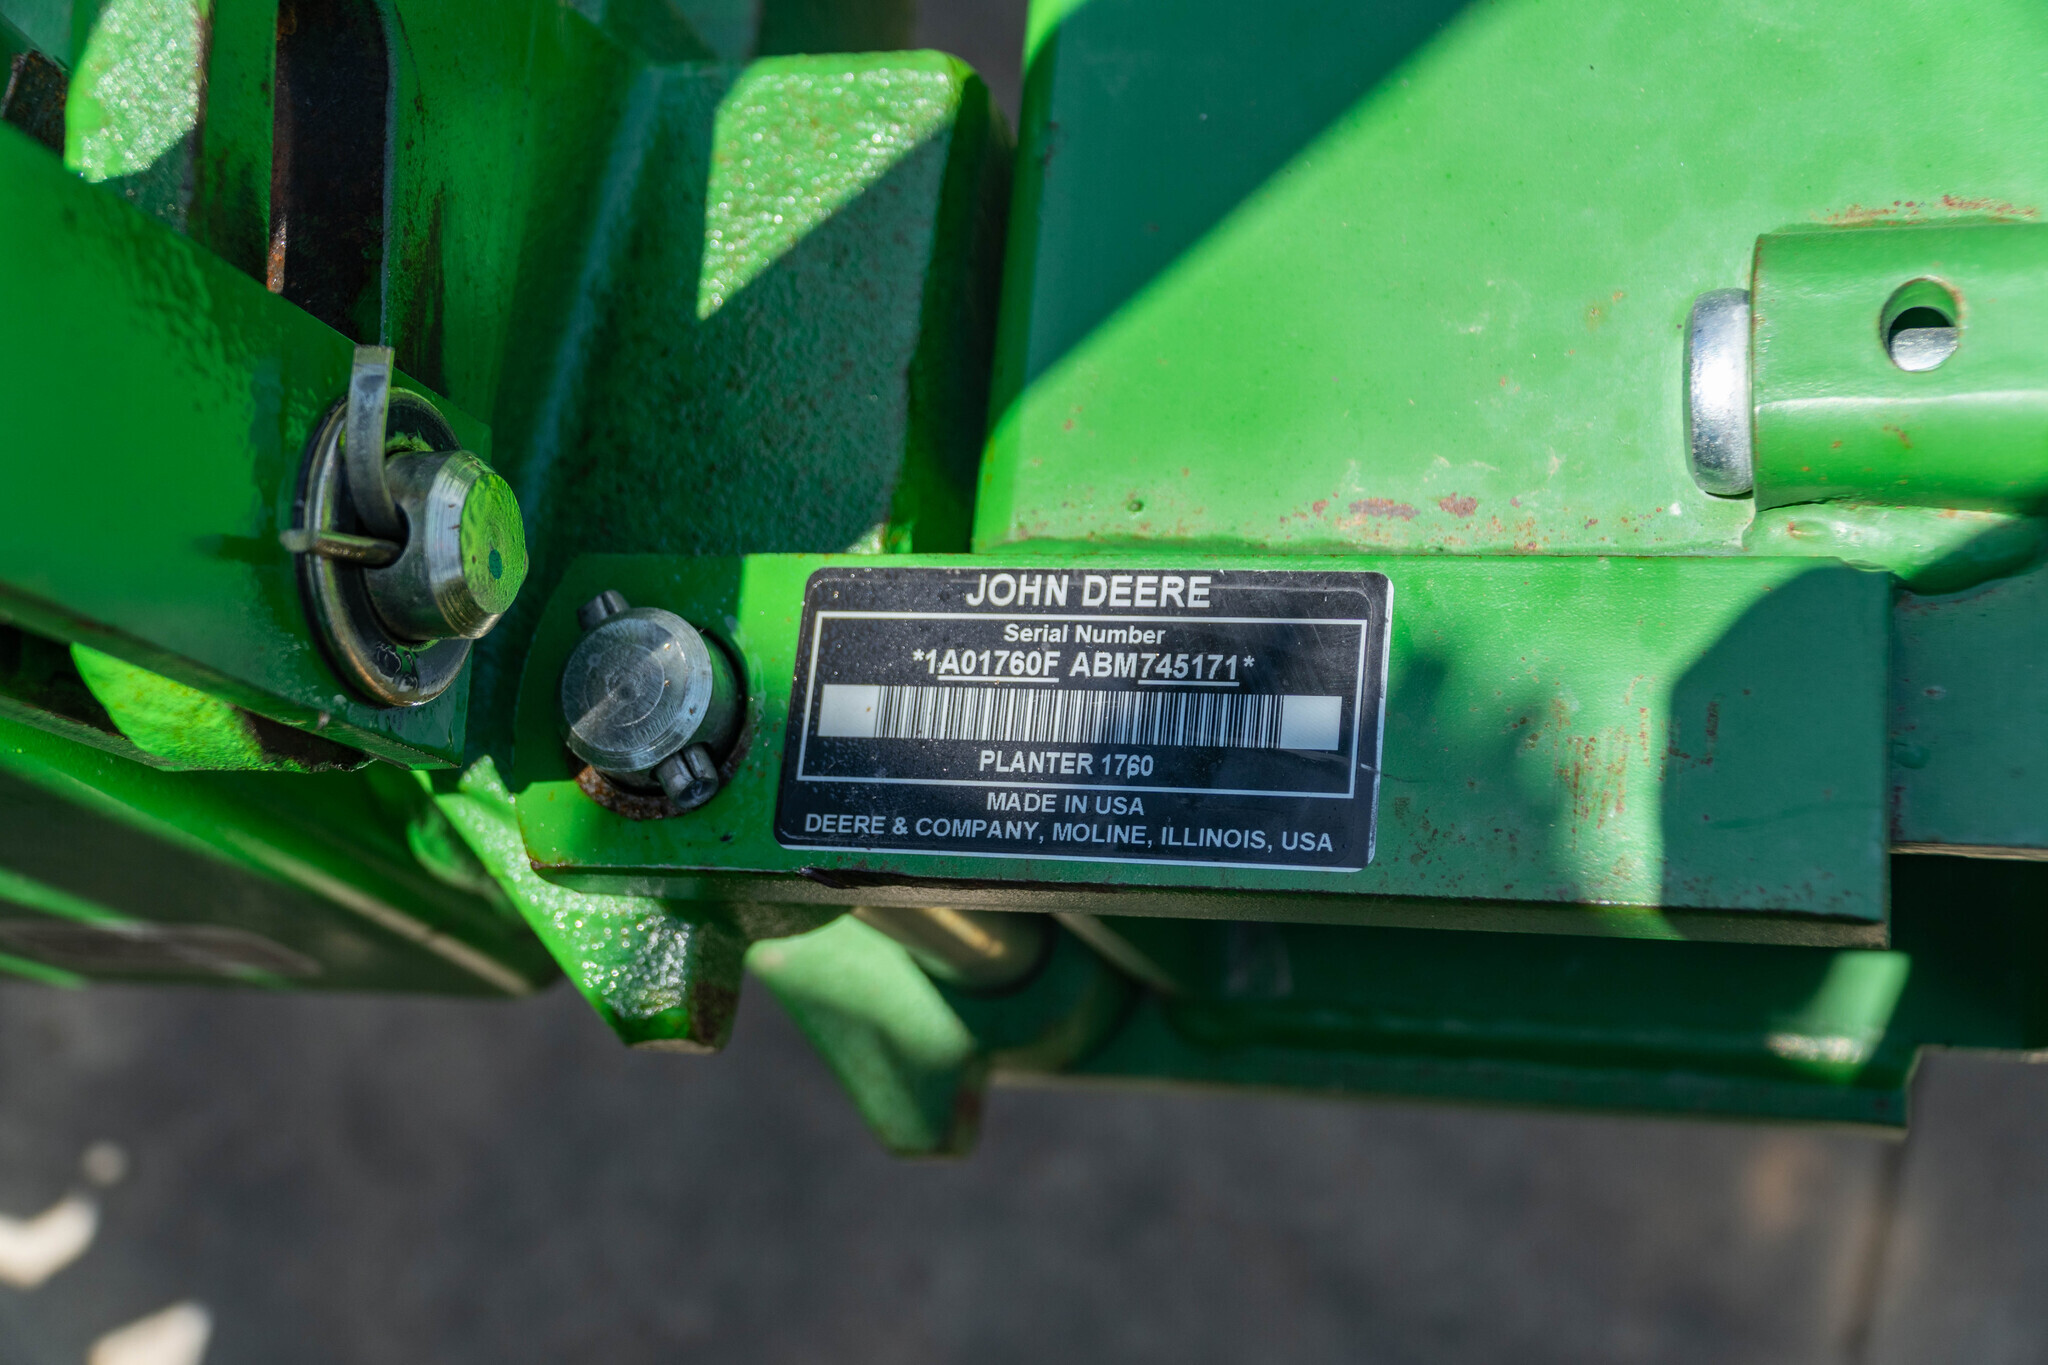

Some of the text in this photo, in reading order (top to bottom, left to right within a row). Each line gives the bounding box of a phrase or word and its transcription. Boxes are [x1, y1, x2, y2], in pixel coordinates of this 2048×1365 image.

[966, 573, 1212, 608] JOHN DEERE
[1003, 624, 1166, 645] Serial Number
[980, 751, 1154, 778] PLANTER 1760
[987, 792, 1144, 816] MADE IN USA
[805, 814, 1333, 853] DEERE & COMPANY, MOLINE, ILLINOIS, USA
